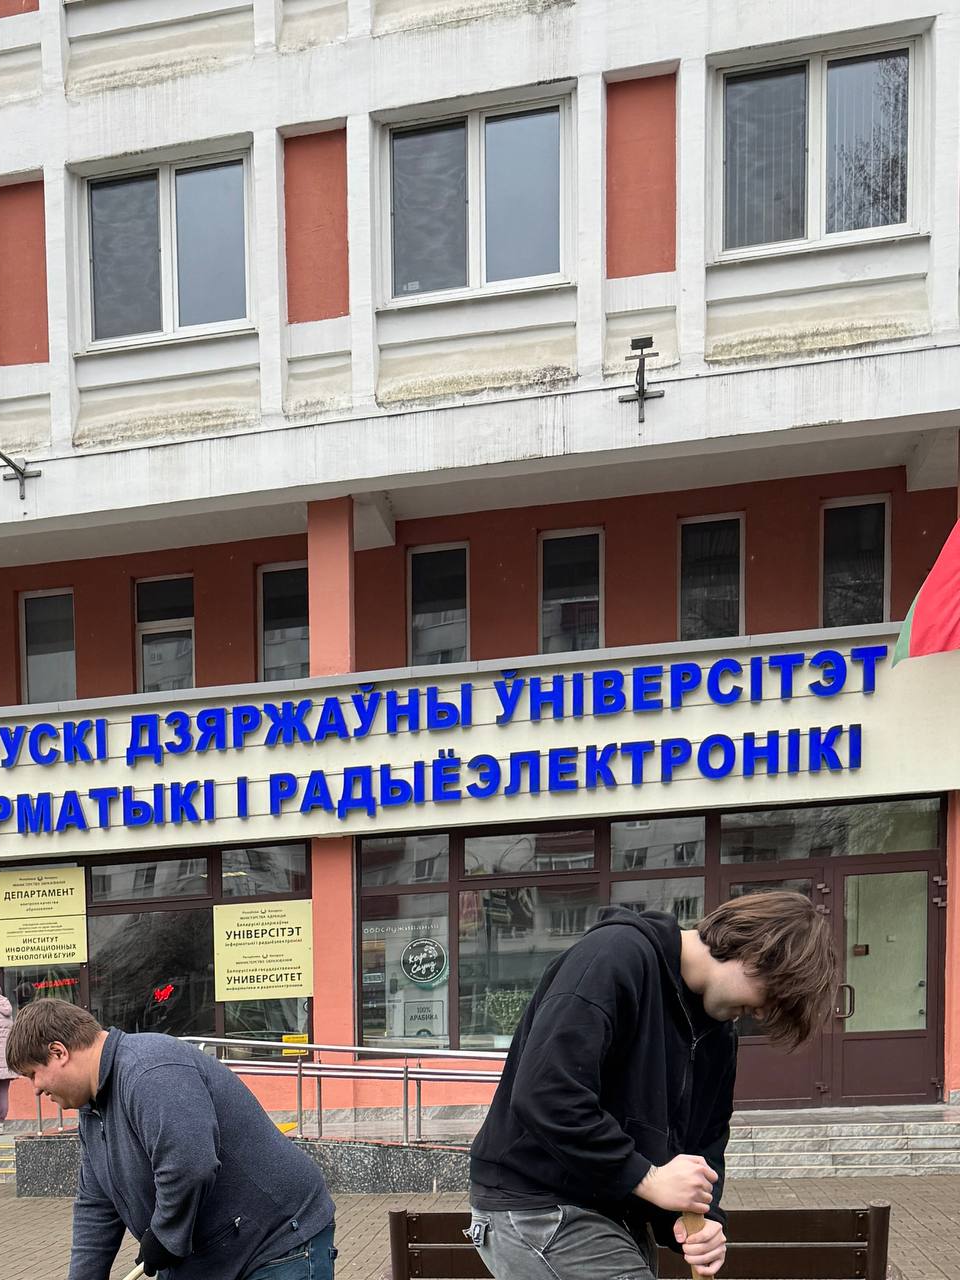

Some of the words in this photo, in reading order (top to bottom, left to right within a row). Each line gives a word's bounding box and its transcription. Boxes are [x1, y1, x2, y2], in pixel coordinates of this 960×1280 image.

[125, 682, 474, 766] ДЗЯРЖАЎНЫ
[494, 645, 889, 725] ЎНІВЕРСІТЭТ
[236, 776, 249, 819] І
[268, 724, 863, 820] РАДЫЁЭЛЕКТРОНІКІ
[3, 887, 75, 902] ДЕПАРТАМЕНТ
[225, 926, 302, 940] УНІВЕРСІТЭТ
[22, 936, 59, 944] ИНСТИТУТ
[5, 943, 77, 953] ИНФОРМАЦИОННЫХ
[6, 952, 53, 962] ТЕХНОЛОГИЙ
[53, 951, 76, 959] БГУИР
[226, 972, 303, 985] УНИВЕРСИТЕТ
[409, 1013, 439, 1021] АРАБИКА
